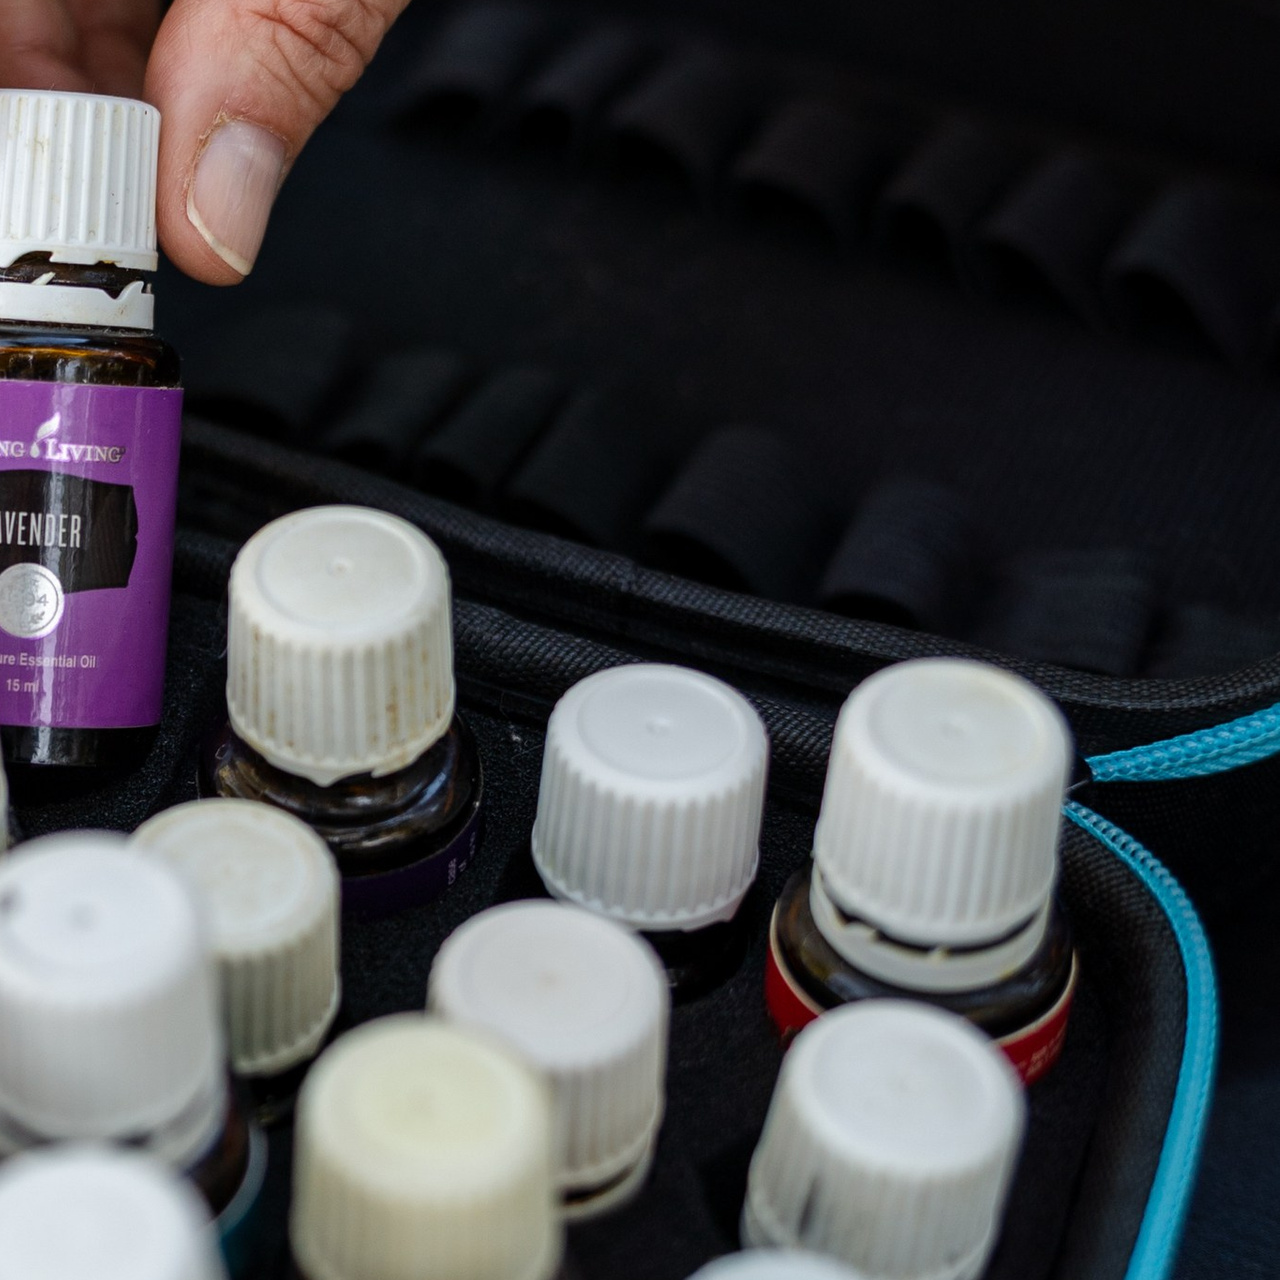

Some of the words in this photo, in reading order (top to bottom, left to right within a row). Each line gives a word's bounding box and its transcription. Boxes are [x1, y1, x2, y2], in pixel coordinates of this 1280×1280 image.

[19, 652, 76, 669] Essential
[79, 654, 97, 669] Oil
[6, 678, 20, 692] 15
[23, 678, 41, 693] ml
